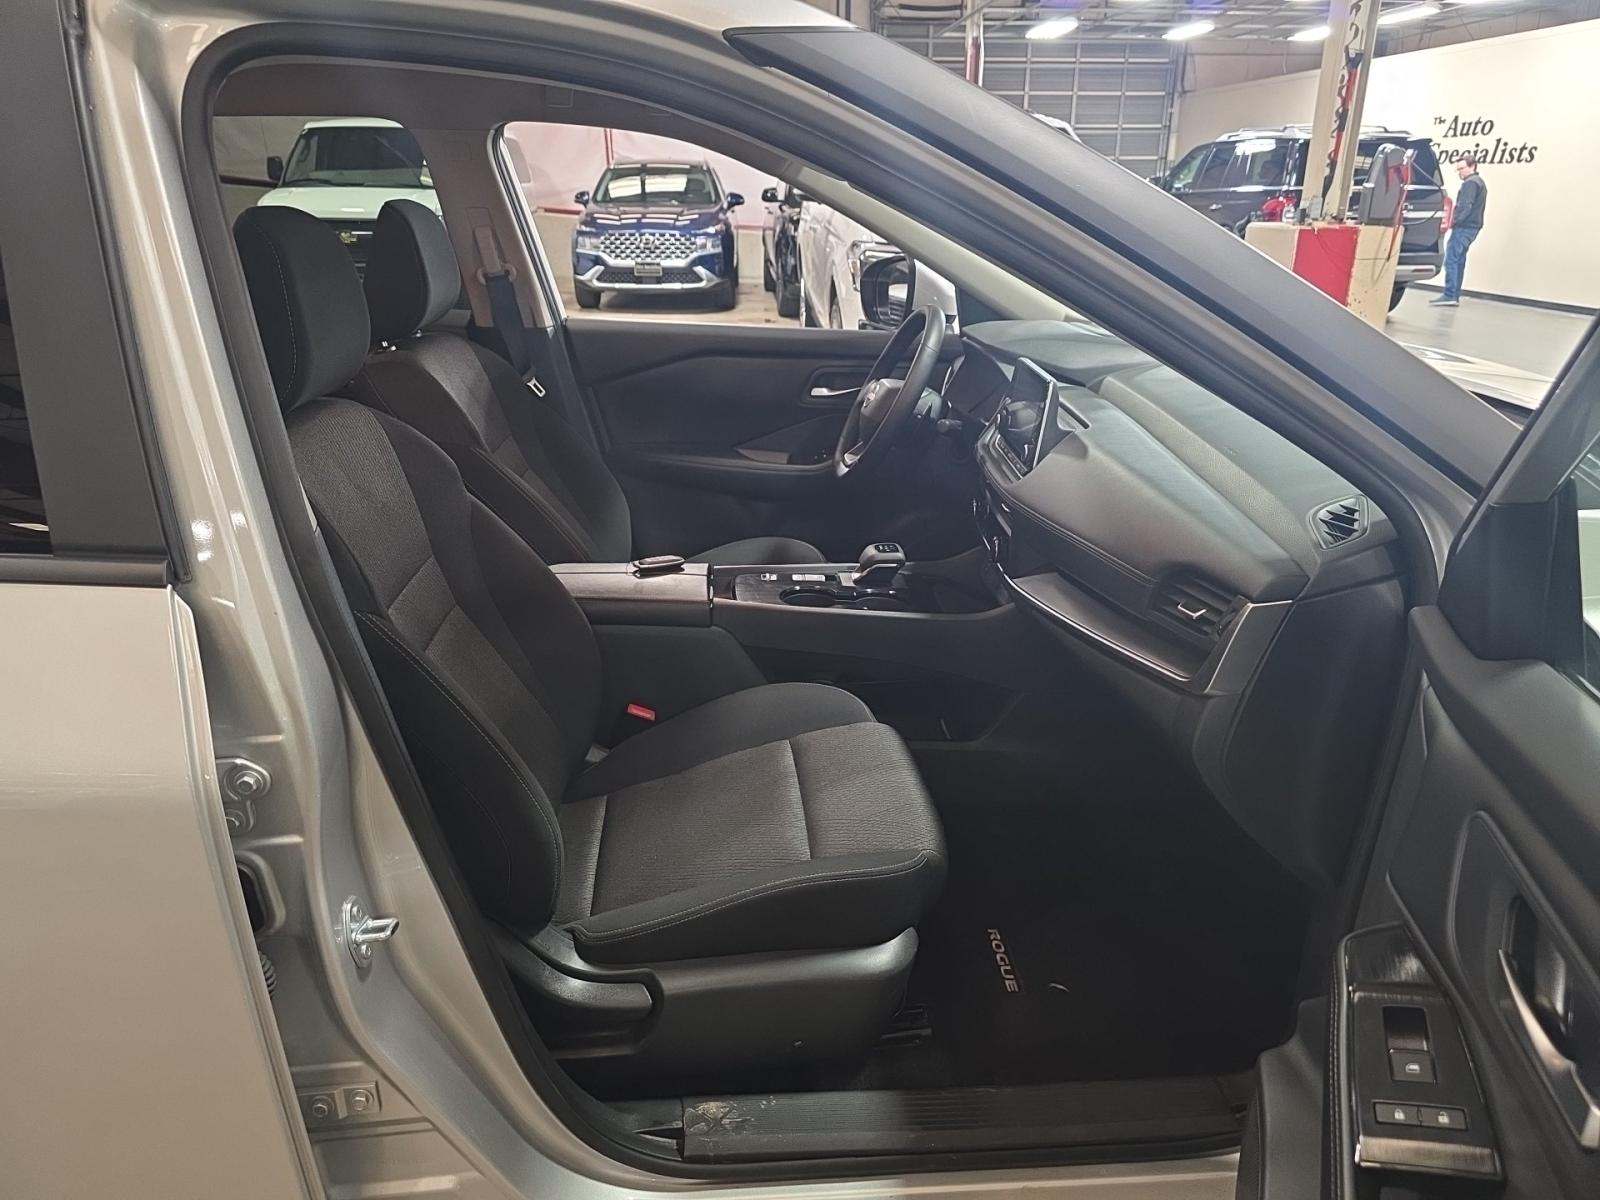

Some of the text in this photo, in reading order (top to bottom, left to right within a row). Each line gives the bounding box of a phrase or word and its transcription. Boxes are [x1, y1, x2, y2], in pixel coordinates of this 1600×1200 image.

[1433, 115, 1494, 138] The Auto
[987, 928, 1020, 993] ROGUE
